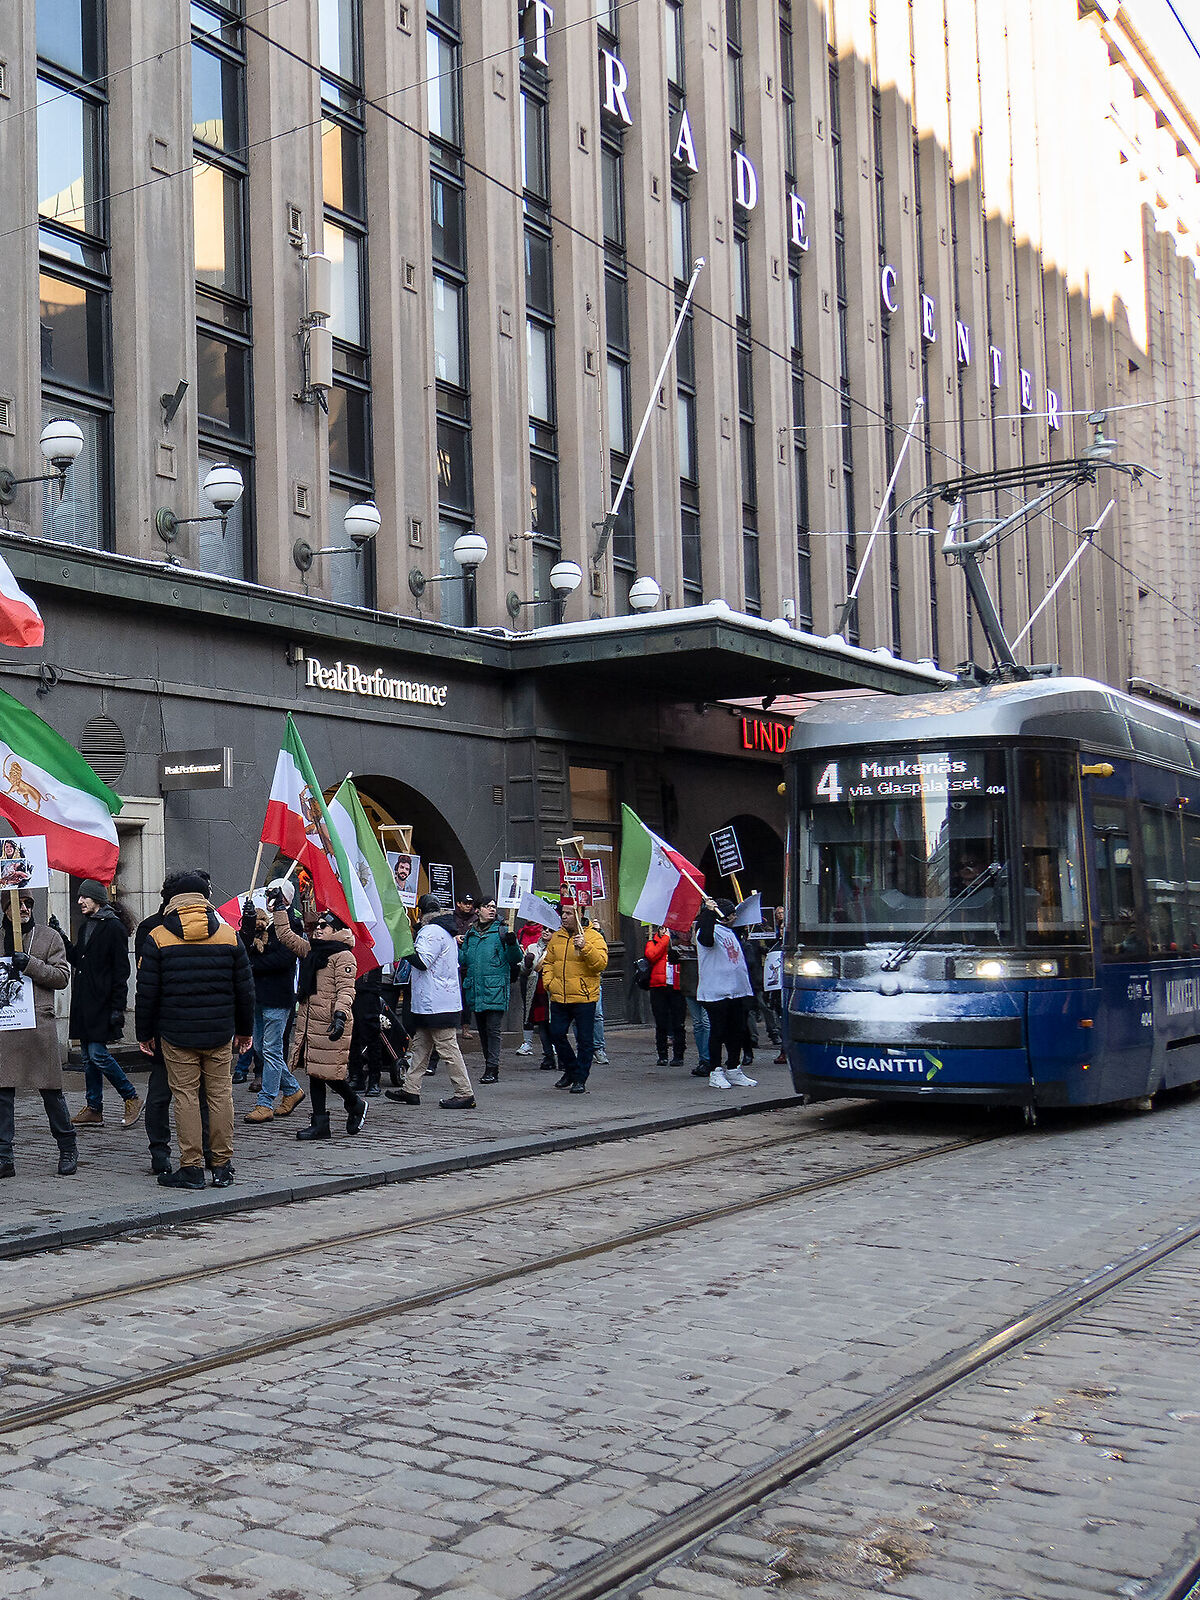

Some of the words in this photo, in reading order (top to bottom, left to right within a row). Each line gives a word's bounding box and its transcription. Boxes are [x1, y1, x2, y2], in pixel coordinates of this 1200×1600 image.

[532, 0, 810, 252] TRADE
[882, 265, 1061, 431] CENTER
[861, 758, 967, 779] Munksnäs
[816, 763, 843, 802] 4
[850, 784, 873, 797] via
[877, 776, 982, 796] Glaspalatset
[986, 785, 1006, 795] 404
[836, 1055, 923, 1072] GIGANTTI
